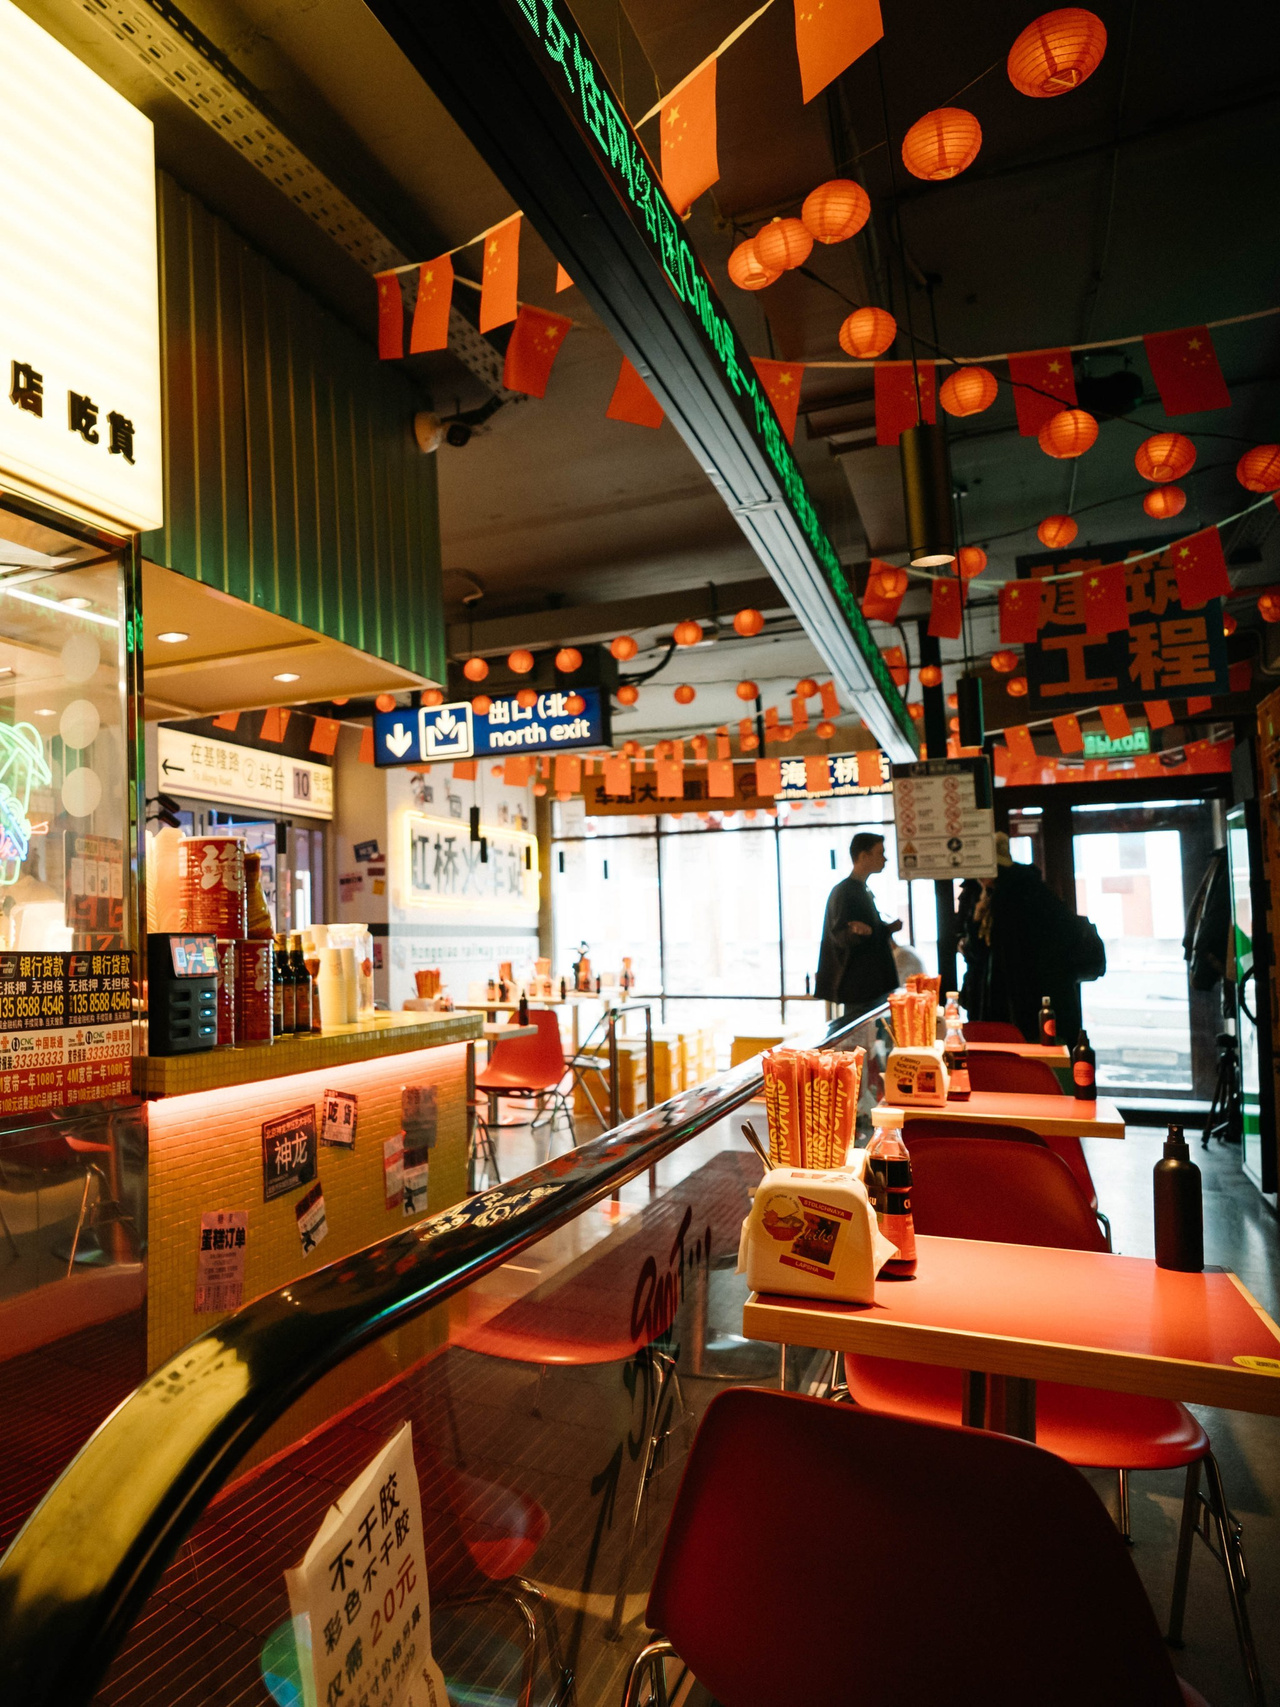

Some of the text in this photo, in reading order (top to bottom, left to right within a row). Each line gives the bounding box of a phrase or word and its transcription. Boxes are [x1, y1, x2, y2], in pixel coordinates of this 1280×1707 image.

[1039, 616, 1216, 697] 工程
[489, 718, 590, 748] north exit
[260, 762, 285, 792] 站台
[295, 771, 310, 797] 10
[20, 956, 63, 977] 银行贷款
[92, 955, 130, 975] 银行贷款
[31, 981, 63, 994] 无担保
[68, 977, 130, 992] 无抵押 无担保
[16, 995, 63, 1017] 8588 4546
[89, 991, 130, 1012] 8588 4546
[274, 1131, 308, 1175] 神龙
[803, 1199, 845, 1218] STOLICHNAYA
[201, 1227, 246, 1251] 蛋糕订单
[328, 1472, 401, 1592] 不干胶
[323, 1508, 410, 1656] 彩色不干胶
